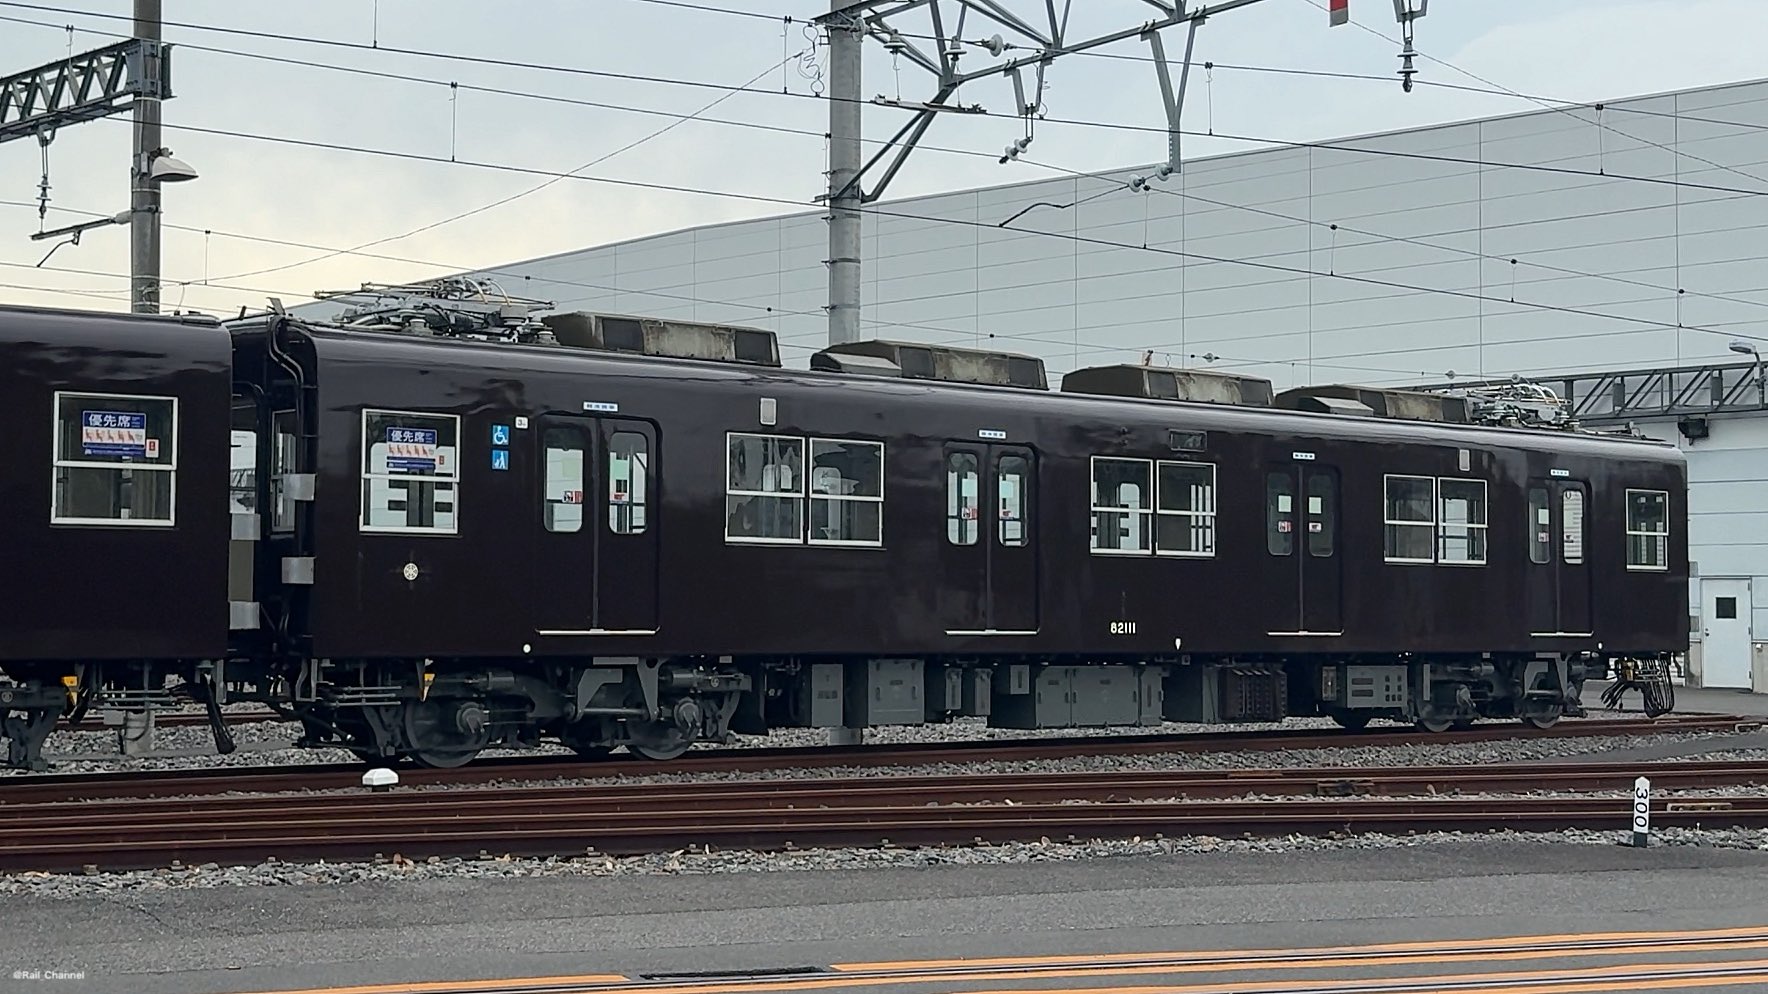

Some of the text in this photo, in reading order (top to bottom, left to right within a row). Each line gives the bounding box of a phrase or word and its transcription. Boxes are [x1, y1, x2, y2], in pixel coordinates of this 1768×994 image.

[89, 414, 131, 427] 優先席
[391, 430, 425, 443] 優先席
[1110, 621, 1136, 634] 82111
[1635, 787, 1648, 827] 300
